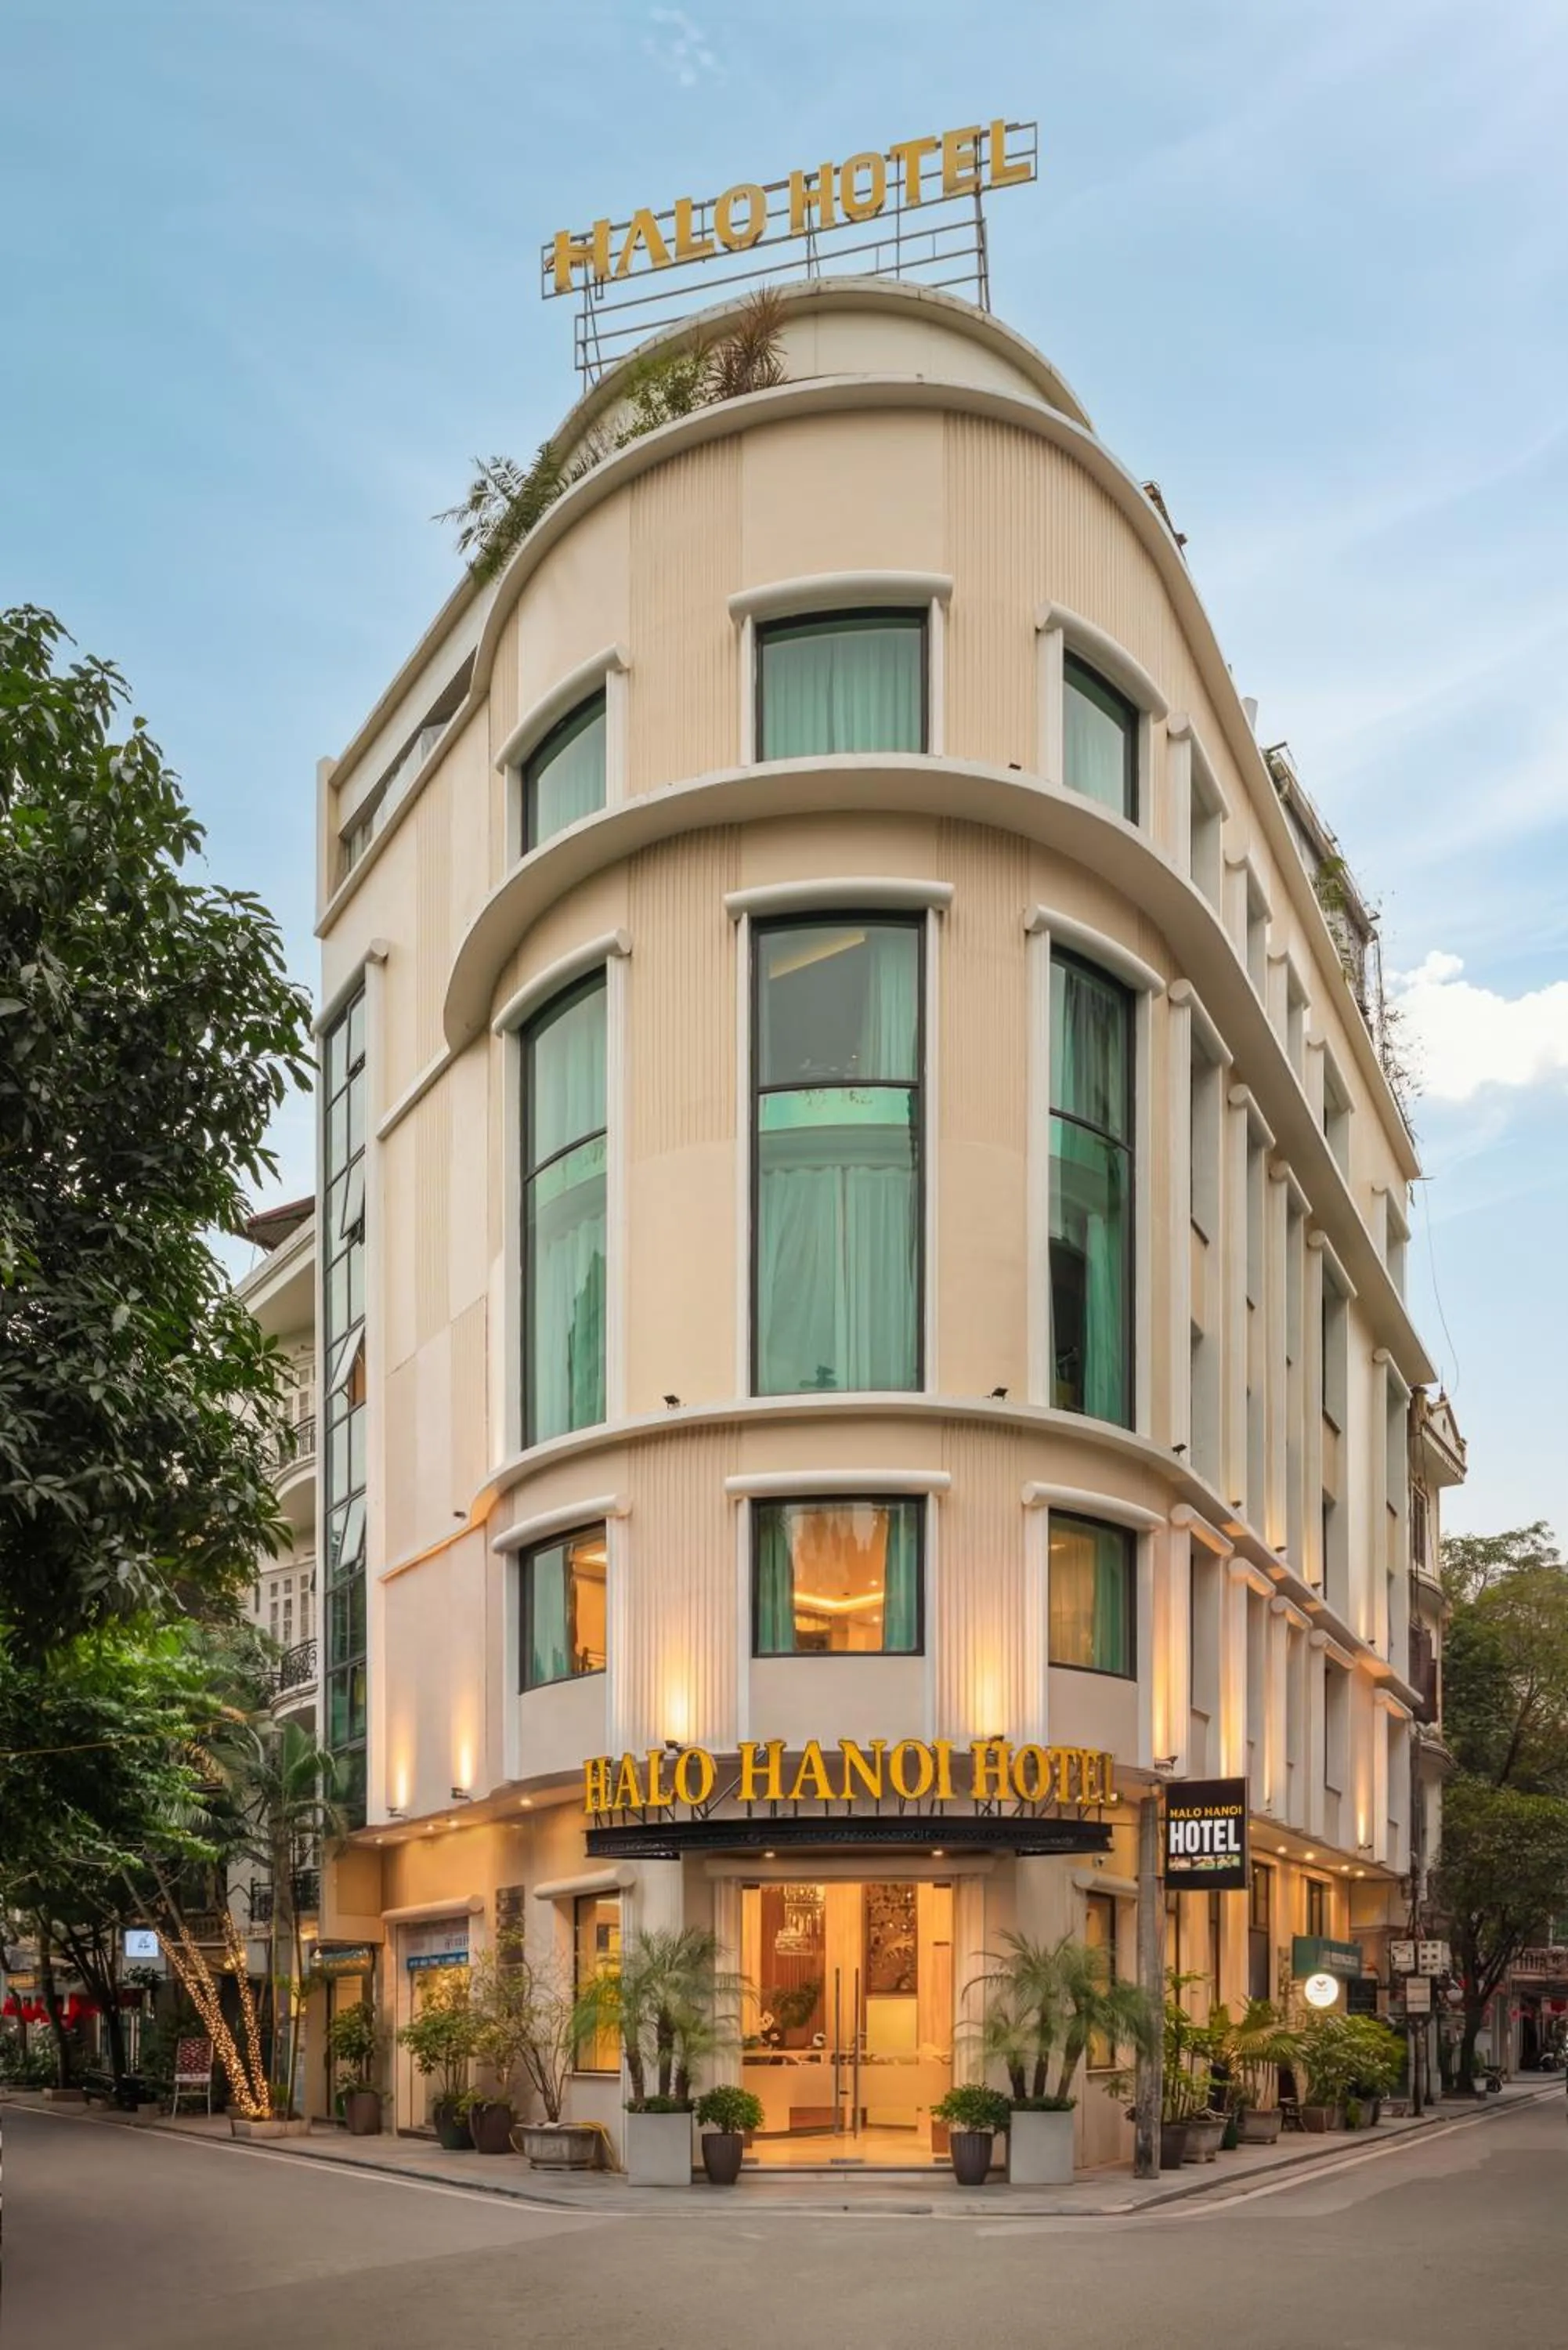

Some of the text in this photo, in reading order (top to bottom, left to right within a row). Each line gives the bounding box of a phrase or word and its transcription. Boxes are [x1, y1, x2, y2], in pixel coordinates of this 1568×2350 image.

[552, 118, 1031, 293] HALO HOTEL
[583, 1746, 717, 1813] HALO
[737, 1738, 957, 1801] HANOI
[1169, 1819, 1241, 1854] HOTEL
[1170, 1806, 1241, 1818] HALO HANOI
